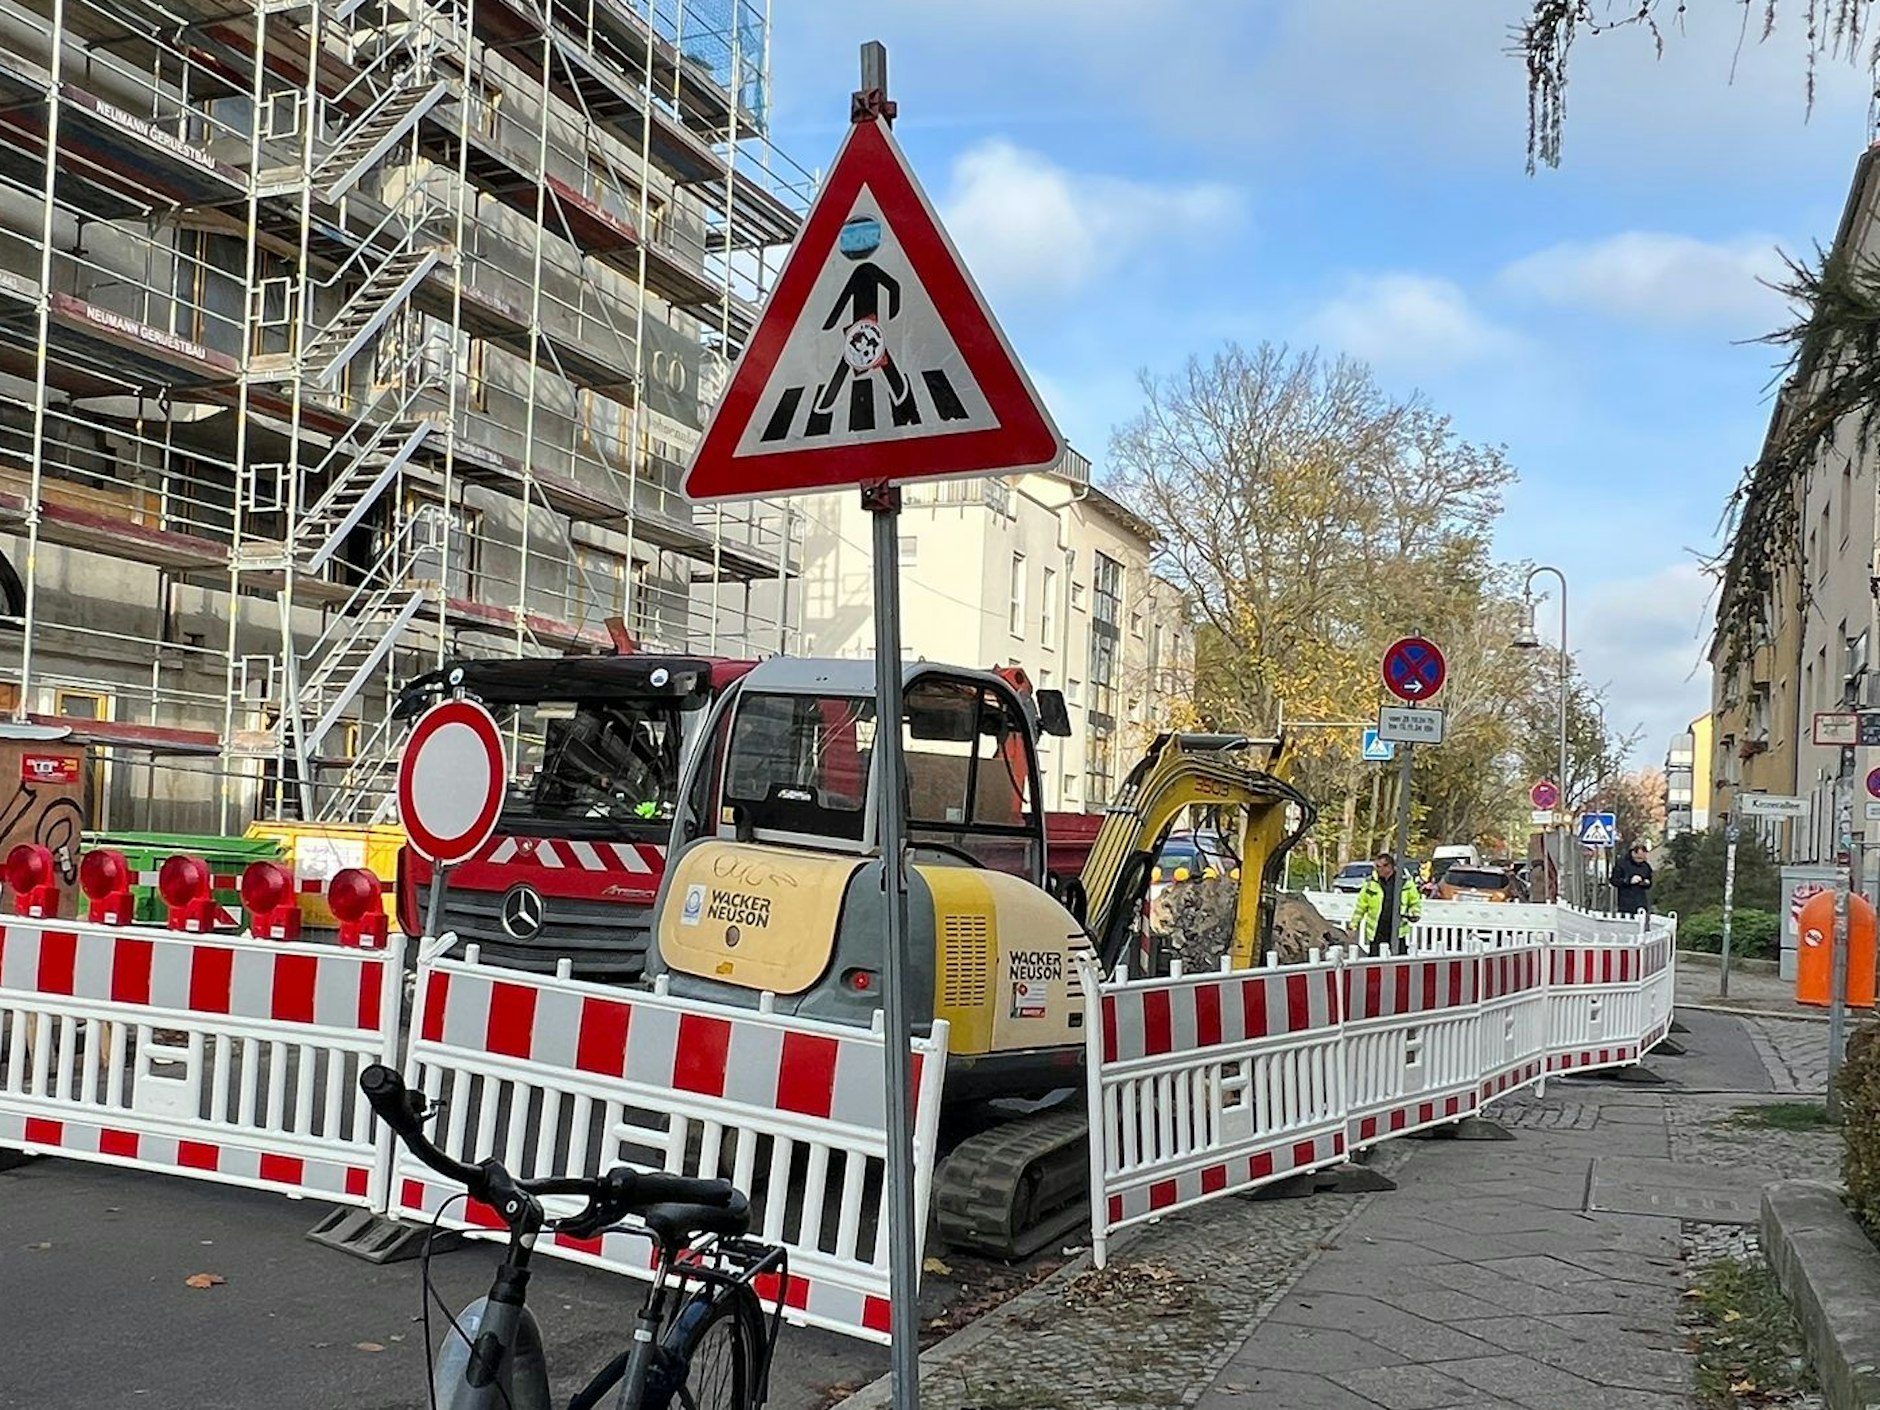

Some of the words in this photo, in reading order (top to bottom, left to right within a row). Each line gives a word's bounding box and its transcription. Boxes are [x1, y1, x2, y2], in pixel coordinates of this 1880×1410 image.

[96, 100, 149, 136] NEUMANN
[149, 127, 215, 169] GERUESTBAU
[86, 306, 139, 336] NEUMANN
[140, 326, 206, 359] GERUESTBAU
[711, 889, 771, 913] WACKER
[707, 905, 769, 928] NEUSON
[1009, 950, 1062, 965] WACKER
[1009, 966, 1062, 980] NEUSON
